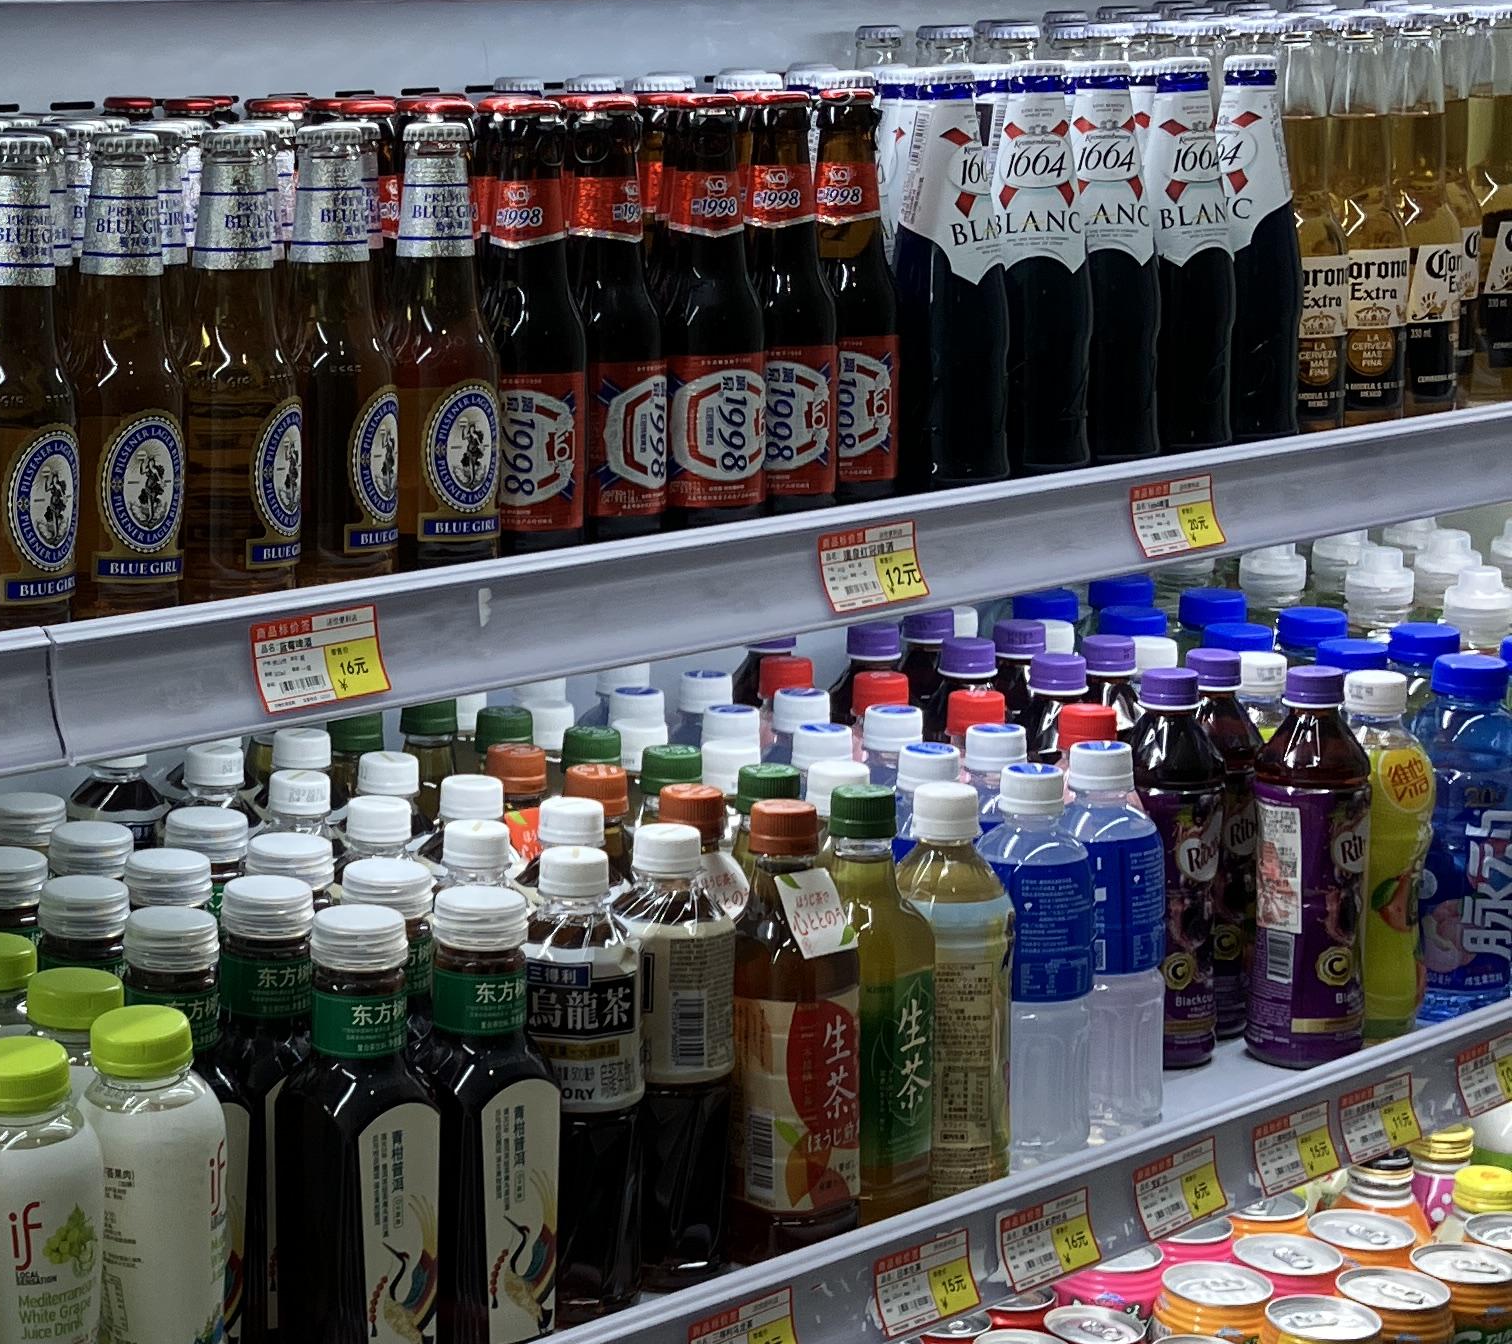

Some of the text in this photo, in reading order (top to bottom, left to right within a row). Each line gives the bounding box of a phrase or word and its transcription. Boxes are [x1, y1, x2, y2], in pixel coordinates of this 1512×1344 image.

[1006, 146, 1067, 179] 1664
[1077, 141, 1136, 172] 1664
[760, 189, 800, 207] 1998
[825, 185, 862, 204] 1998
[700, 197, 736, 216] 1998
[502, 208, 542, 226] 1998
[1350, 283, 1397, 301] Extra
[1351, 340, 1393, 353] CERVEZA
[1361, 358, 1383, 367] FINA
[435, 520, 471, 534] BLUE
[1188, 515, 1210, 532] 20元
[109, 561, 178, 576] BLUE GIRL
[886, 563, 921, 588] 12元
[19, 582, 54, 598] BLUE
[340, 657, 369, 676] 16元
[529, 964, 577, 986] 三得利
[529, 986, 632, 1031] 烏龍茶
[896, 998, 931, 1112] 生茶
[823, 1014, 858, 1121] 生茶
[1193, 1182, 1211, 1200] 6元
[1064, 1231, 1089, 1251] 16元
[941, 1275, 967, 1295] 15元
[18, 1307, 55, 1326] White
[20, 1317, 85, 1341] Juice Drink
